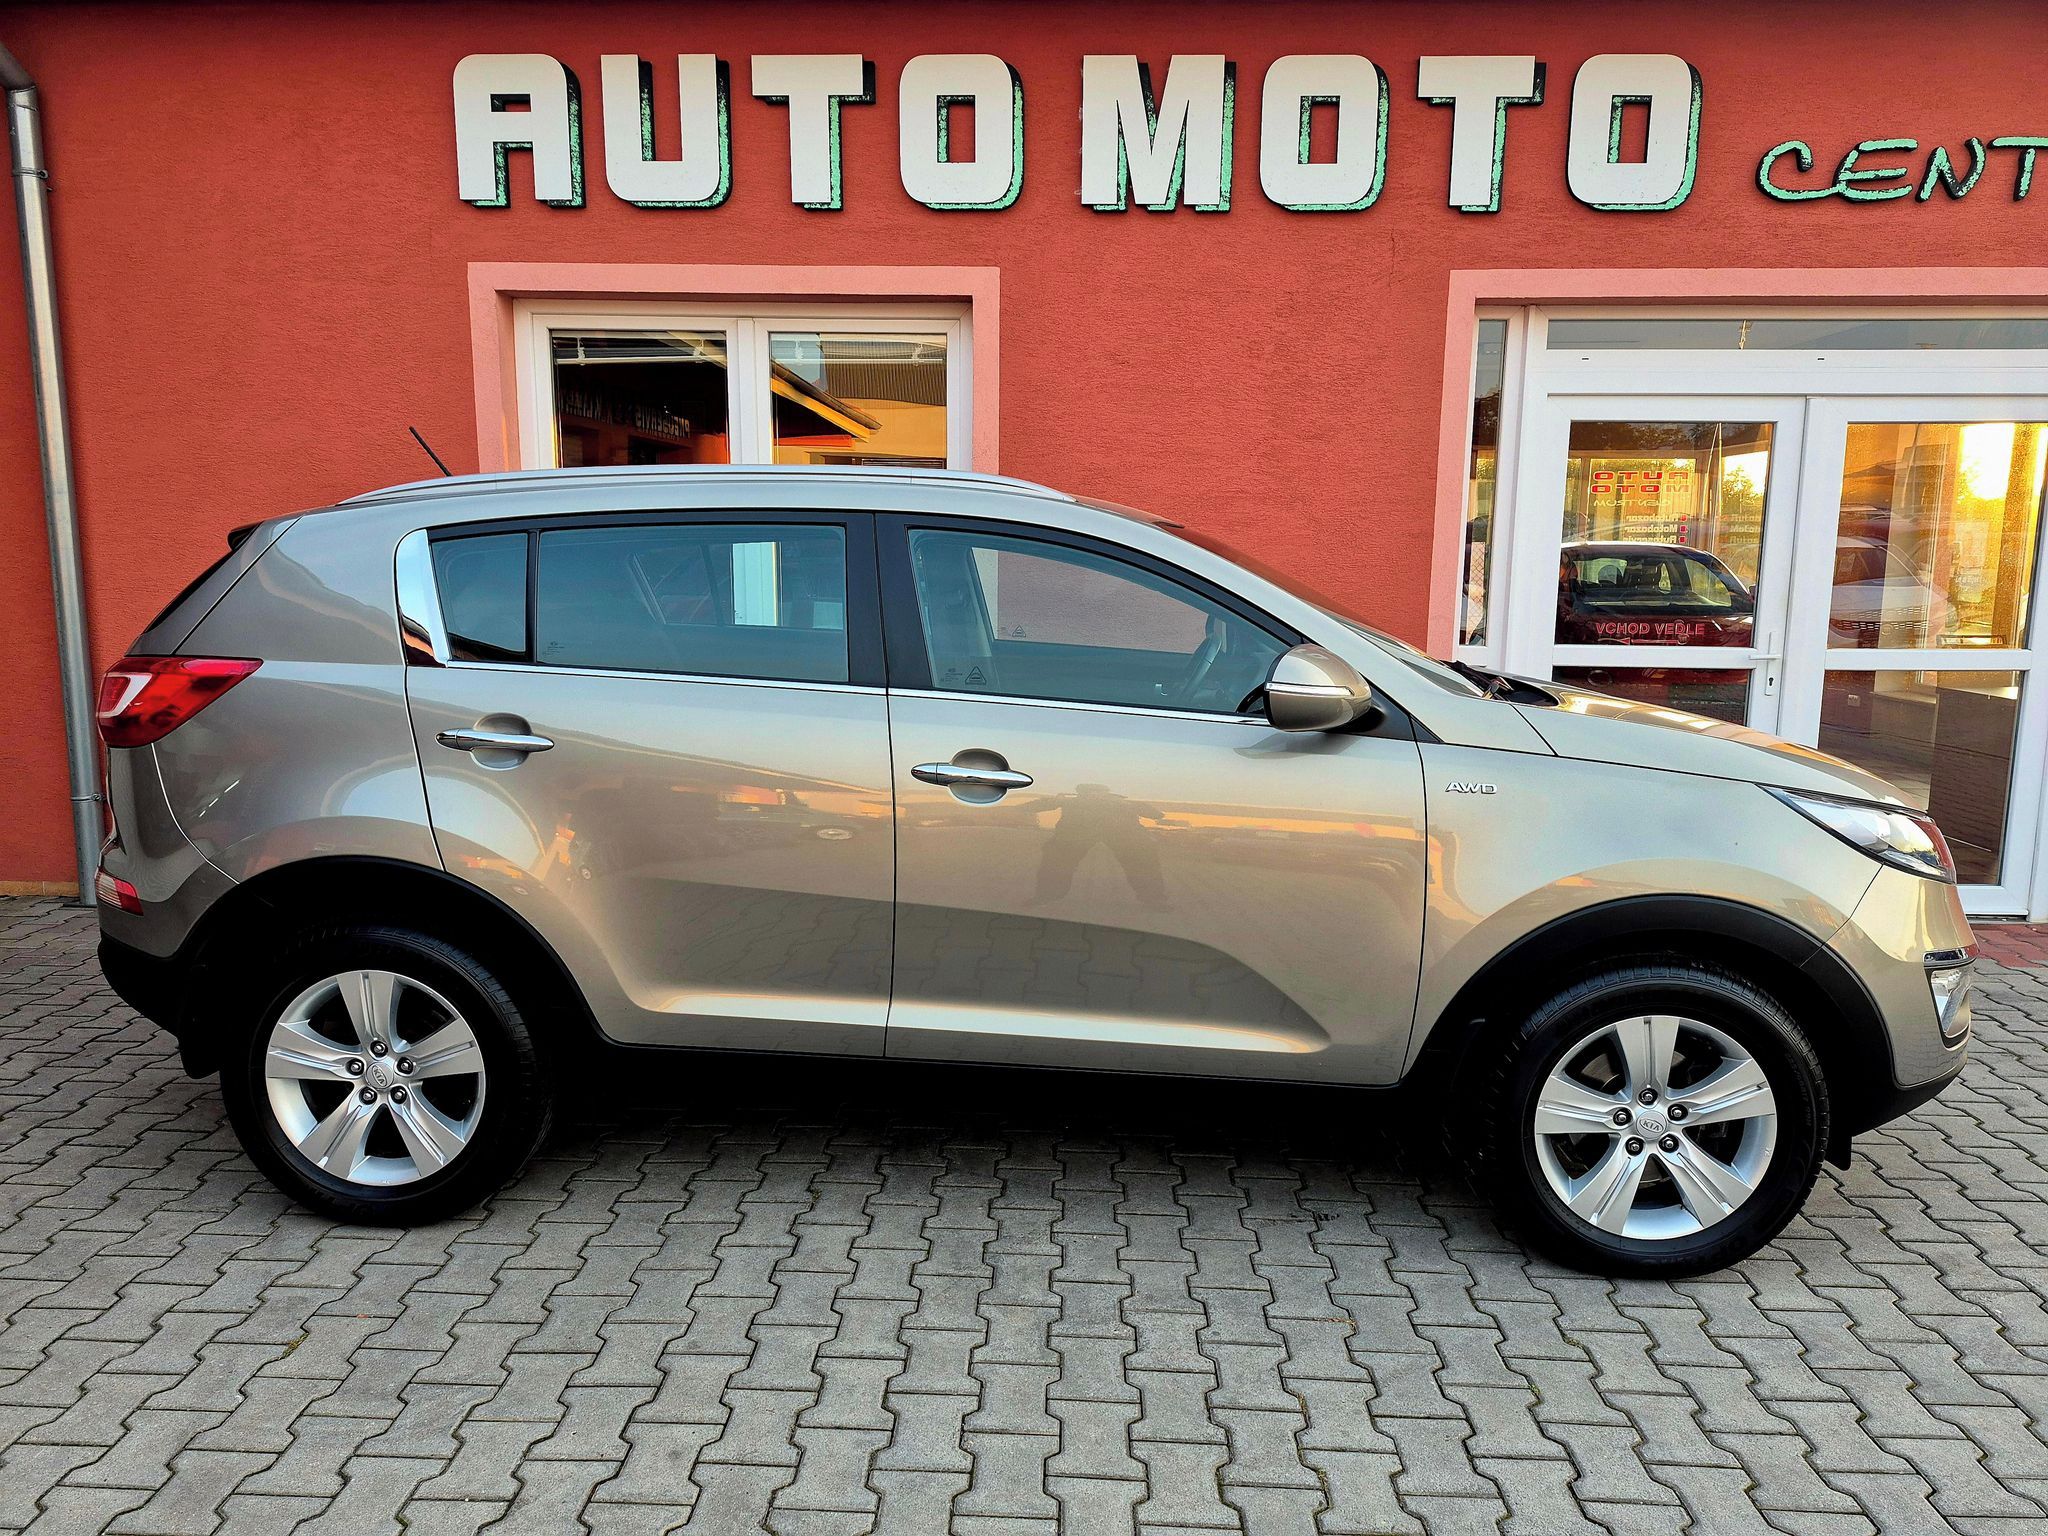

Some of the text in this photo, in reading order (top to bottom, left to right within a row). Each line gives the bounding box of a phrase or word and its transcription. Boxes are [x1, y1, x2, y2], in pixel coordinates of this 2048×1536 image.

[453, 53, 2048, 212] AUTO MOTO CENT
[1595, 622, 1705, 635] VCHOD VEDLE
[1445, 781, 1498, 794] AWD
[373, 1068, 385, 1085] KIA
[1642, 1119, 1661, 1131] KIA
